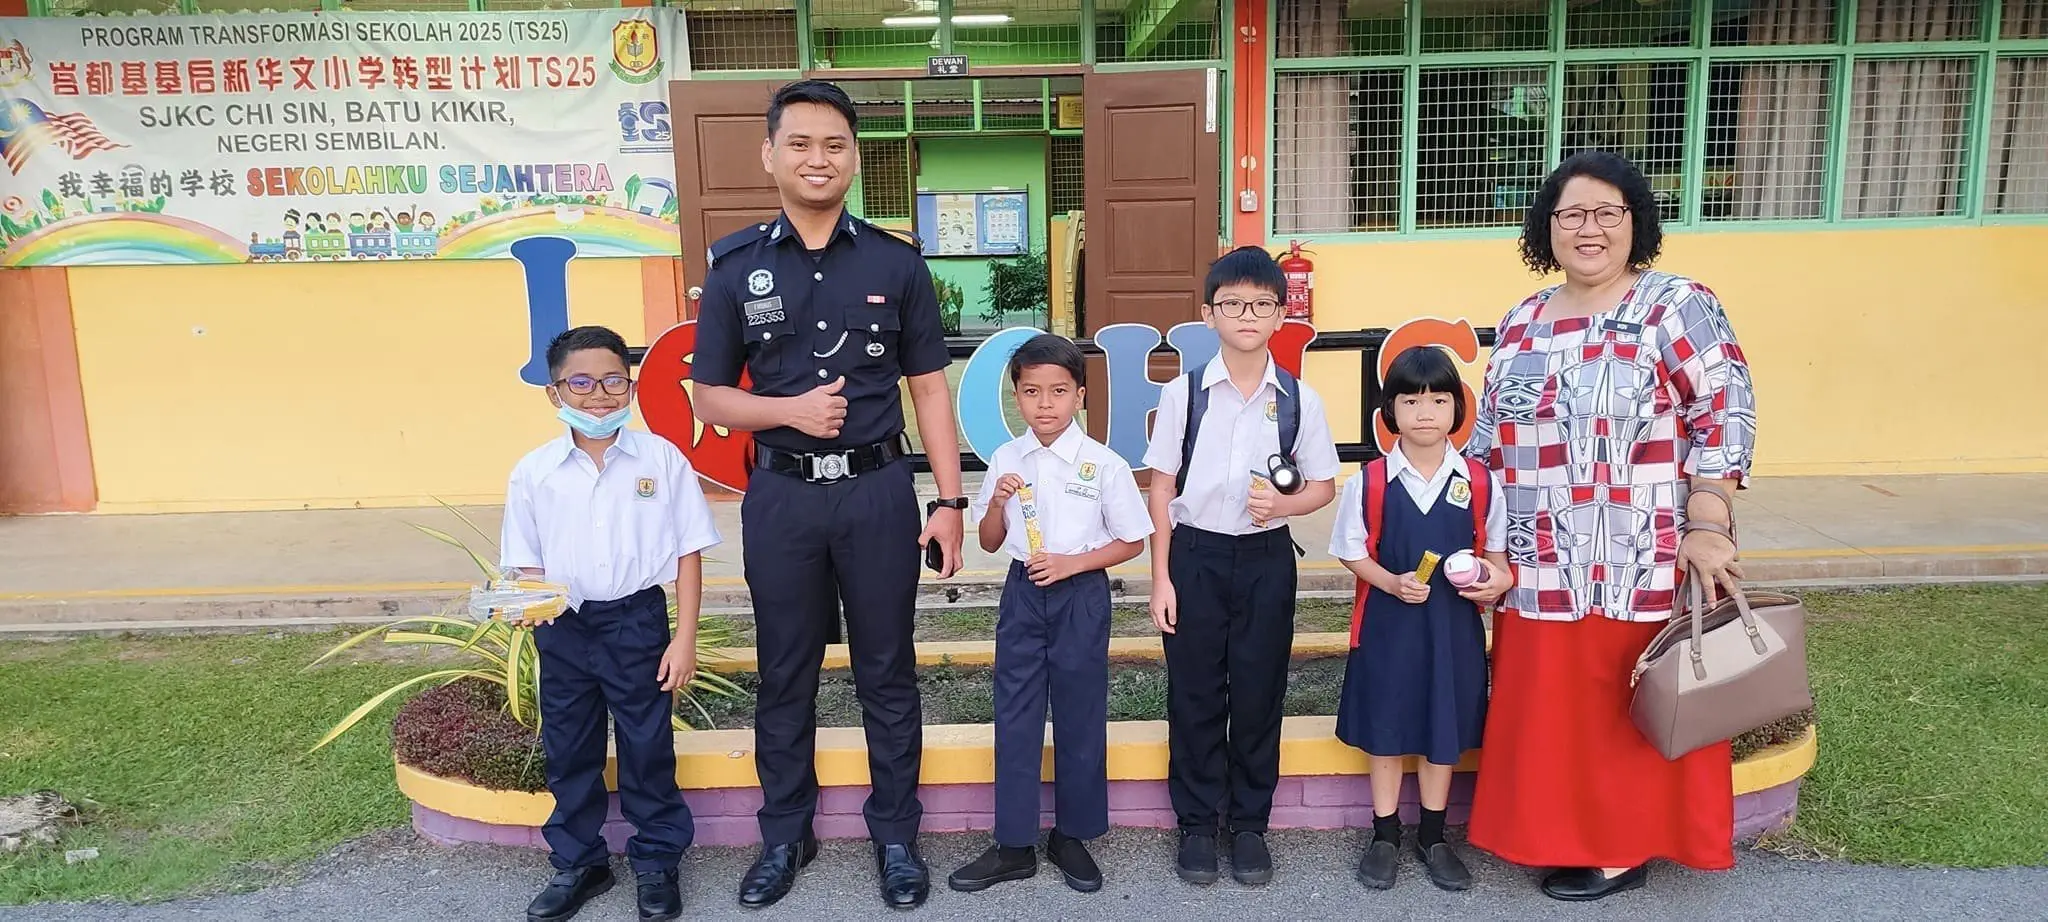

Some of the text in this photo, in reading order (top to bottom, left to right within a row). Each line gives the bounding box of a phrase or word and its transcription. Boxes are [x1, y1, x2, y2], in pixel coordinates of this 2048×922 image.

[81, 19, 569, 47] PROGRAM TRANSFORMASI SEKOLAH 2025 (TS25)
[932, 57, 963, 66] DEWAN
[140, 100, 515, 127] SJKC CHI SIN, BATU KIKIR,
[218, 132, 446, 153] NEGERI SEMBILAN.
[58, 169, 237, 199] 我幸福的学校
[247, 163, 614, 197] SEKOLAHKU SEJAHTERA
[747, 310, 786, 326] 225353
